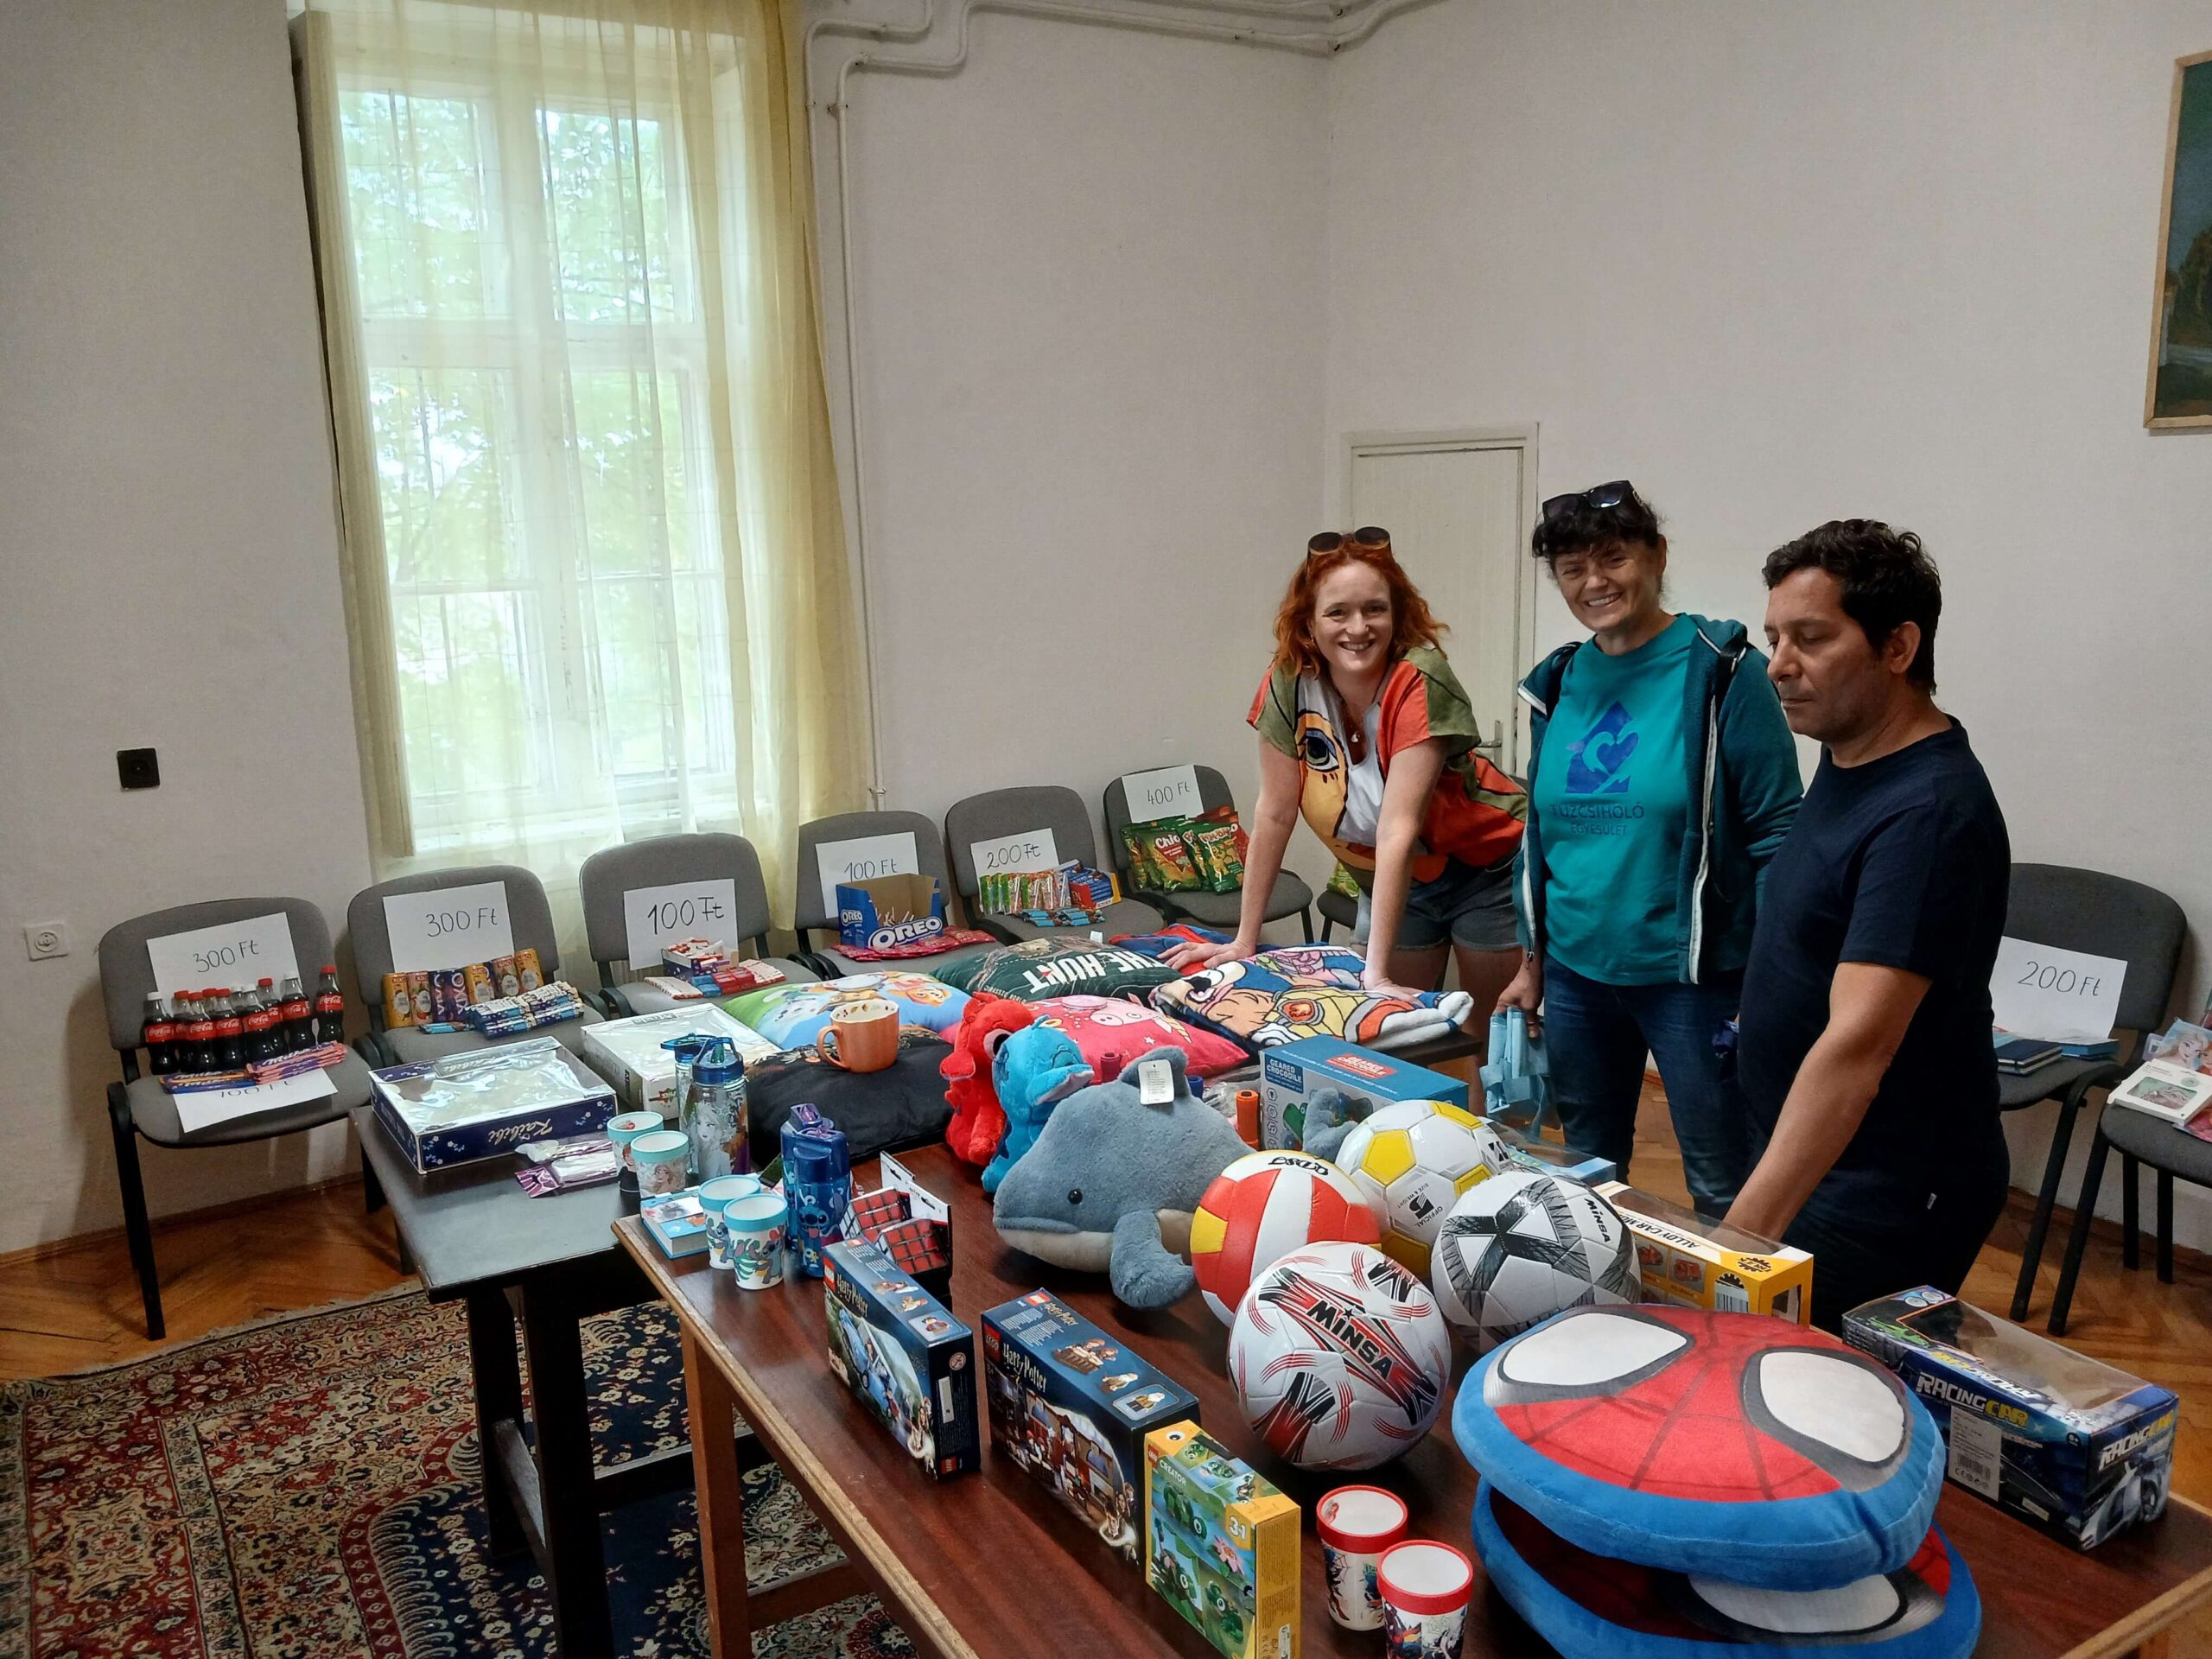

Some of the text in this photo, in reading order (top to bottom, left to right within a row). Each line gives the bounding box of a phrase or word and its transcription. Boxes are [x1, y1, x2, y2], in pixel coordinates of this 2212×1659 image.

[1147, 781, 1191, 805] 400 Ft
[1155, 834, 1180, 849] Chio
[987, 843, 1041, 869] 200 Ft
[844, 858, 899, 882] 100 Ft
[425, 906, 498, 938] 300 Ft
[648, 896, 724, 935] 100 Ft
[873, 918, 941, 948] OREO
[193, 939, 259, 973] 300 Ft
[1022, 954, 1106, 994] HUNT
[2018, 961, 2101, 996] 200 Ft
[1267, 1065, 1303, 1084] CROCODILE
[1269, 1058, 1296, 1073] GEARED
[488, 1118, 553, 1145] Kaibibi
[1414, 1205, 1443, 1228] OFFICIAL
[1637, 1222, 1662, 1236] CAR
[1662, 1231, 1700, 1249] ALLOY
[836, 1274, 852, 1303] Harry
[852, 1286, 868, 1318] Potter
[986, 1335, 999, 1351] LEGO
[1002, 1343, 1046, 1393] Harry Potter
[1160, 1460, 1187, 1486] CREATOR
